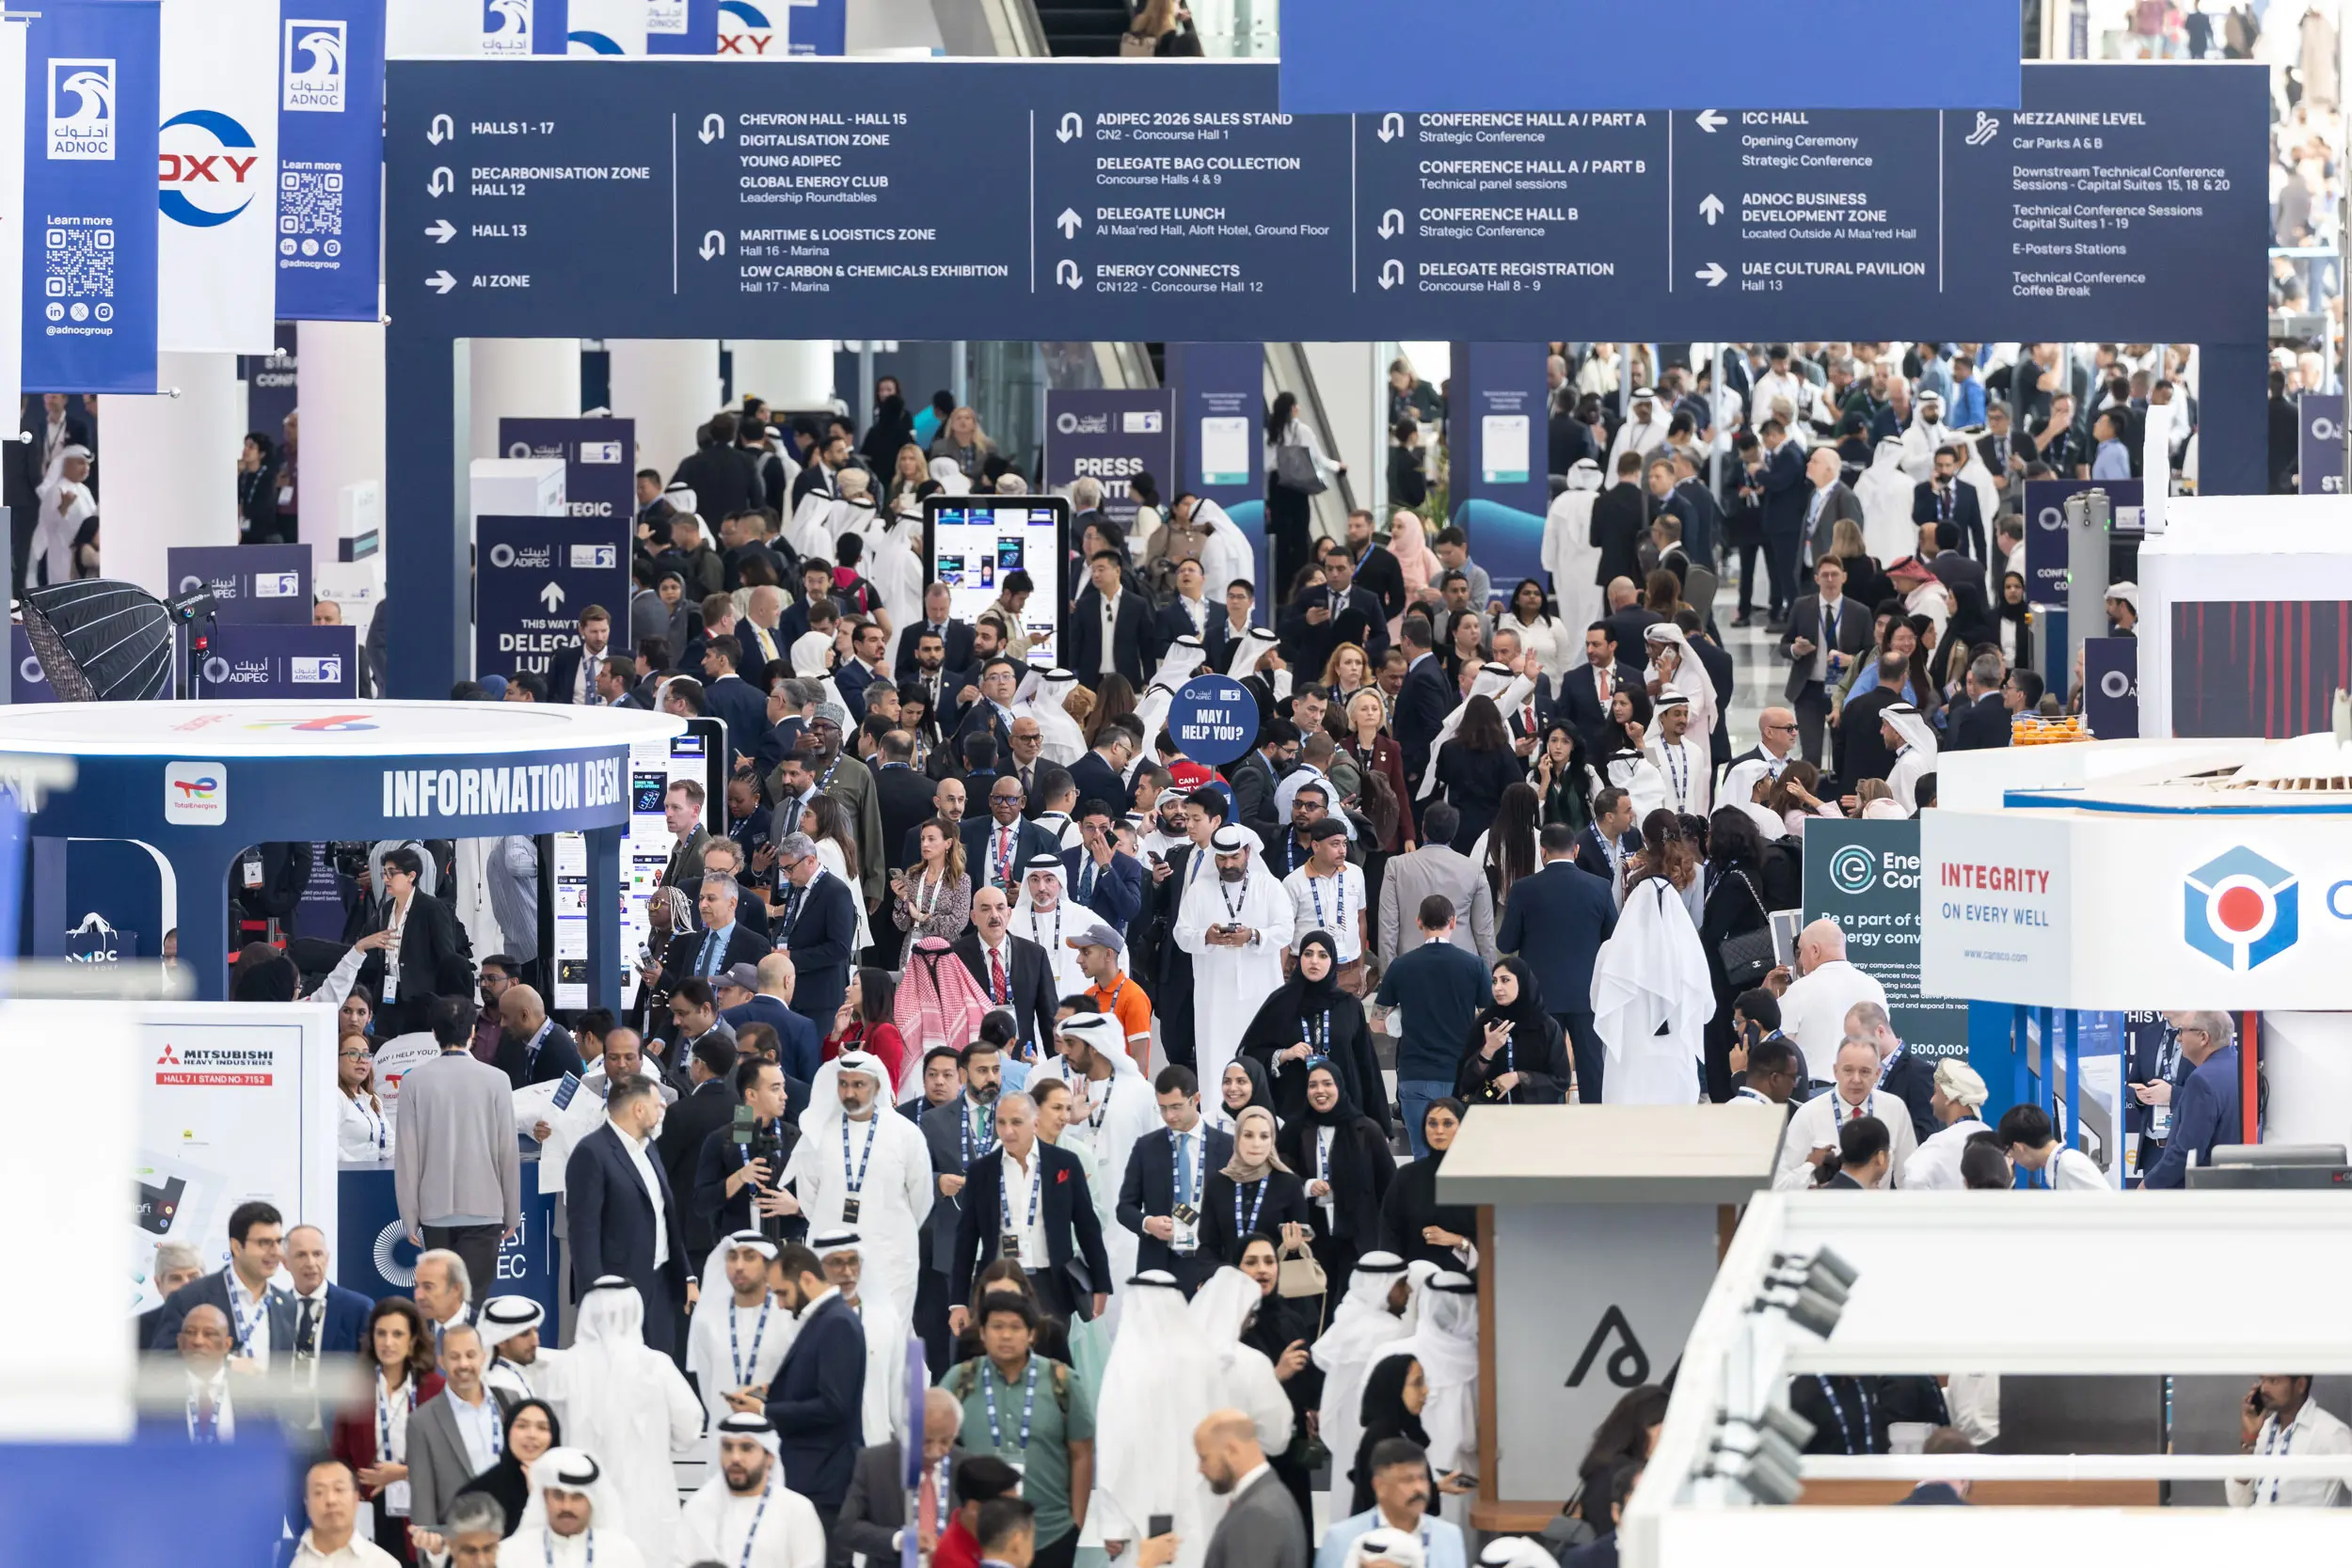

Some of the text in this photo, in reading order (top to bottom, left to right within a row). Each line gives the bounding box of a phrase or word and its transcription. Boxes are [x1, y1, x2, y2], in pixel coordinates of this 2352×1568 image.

[718, 35, 772, 55] XY
[290, 94, 339, 105] ADNOC
[739, 114, 807, 125] CHEVRON
[810, 114, 845, 124] HALL
[855, 114, 890, 124] HALL
[893, 114, 907, 124] 15
[1096, 113, 1293, 125] ADIPEC 2026 SALES STAND
[1742, 112, 1808, 124] ICC HALL
[2013, 113, 2145, 125] MEZZANINE LEVEL
[471, 122, 518, 135] HALLS
[521, 122, 527, 134] 1
[540, 122, 554, 134] 17
[740, 135, 889, 146] DIGITALISATION ZONE
[1741, 135, 1858, 149] Opening Ceremony
[55, 141, 108, 153] ADNOC
[282, 160, 342, 171] Learn more
[740, 155, 841, 166] YOUNG ADIPEC
[1097, 157, 1300, 169] DELEGATE BAG COLLECTION
[1742, 155, 1872, 168] Strategic Conference
[472, 167, 649, 179] DECARBONISATION ZONE
[2013, 166, 2225, 178] Downstream Technical Conference
[740, 176, 888, 188] GLOBAL ENERGY CLUB
[1419, 178, 1567, 191] Technical panel sessions
[740, 192, 877, 204] Leadership Roundtables
[1742, 193, 1867, 205] ADNOC BUSINESS
[1097, 208, 1225, 219] DELEGATE LUNCH
[1420, 208, 1578, 220] CONFERENCE HALL B
[1742, 210, 1886, 221] DEVELOPMENT ZONE
[47, 214, 113, 226] Learn more
[740, 229, 935, 240] MARITIME & LOGISTICS ZONE
[1096, 225, 1329, 236] Al Maa'red Hall, Aloft Hotel, Ground Floor
[2013, 244, 2126, 254] E-Posters Stations
[279, 259, 341, 270] @adnocgroup
[1097, 264, 1240, 277] ENERGY CONNECTS
[1420, 263, 1613, 276] DELEGATE REGISTRATION
[1742, 262, 1925, 275] UAE CULTURAL PAVILION
[741, 265, 1008, 277] LOW CARBON & CHEMICALS EXHIBITION
[472, 275, 530, 287] AI ZONE
[46, 325, 113, 336] @adnocgroup
[1073, 457, 1145, 477] PRESS
[565, 501, 612, 516] TEGIC
[514, 558, 550, 568] ADIPEC
[521, 619, 547, 629] THIS
[548, 619, 568, 629] WAY
[500, 633, 584, 653] DELEGA
[229, 673, 269, 683] ADIPEC
[1196, 708, 1231, 724] MAY I
[1182, 724, 1244, 741] HELP YOU?
[383, 756, 621, 817] INFORMATION DESK
[1178, 777, 1195, 785] CAN
[174, 801, 218, 811] TotalEnergies
[1883, 852, 1921, 870] Ene
[1941, 862, 2050, 895] INTEGRITY
[1843, 915, 1854, 926] a
[1858, 913, 1891, 928] part
[1894, 912, 1911, 927] of
[1942, 902, 2049, 927] ON EVERY WELL
[183, 1050, 274, 1059] MITSUBISHI
[1910, 1043, 1969, 1057] 500,000+
[377, 1054, 391, 1065] MAY
[395, 1050, 415, 1059] HELP
[164, 1074, 265, 1085] HALL 7 STAND NO: 7152
